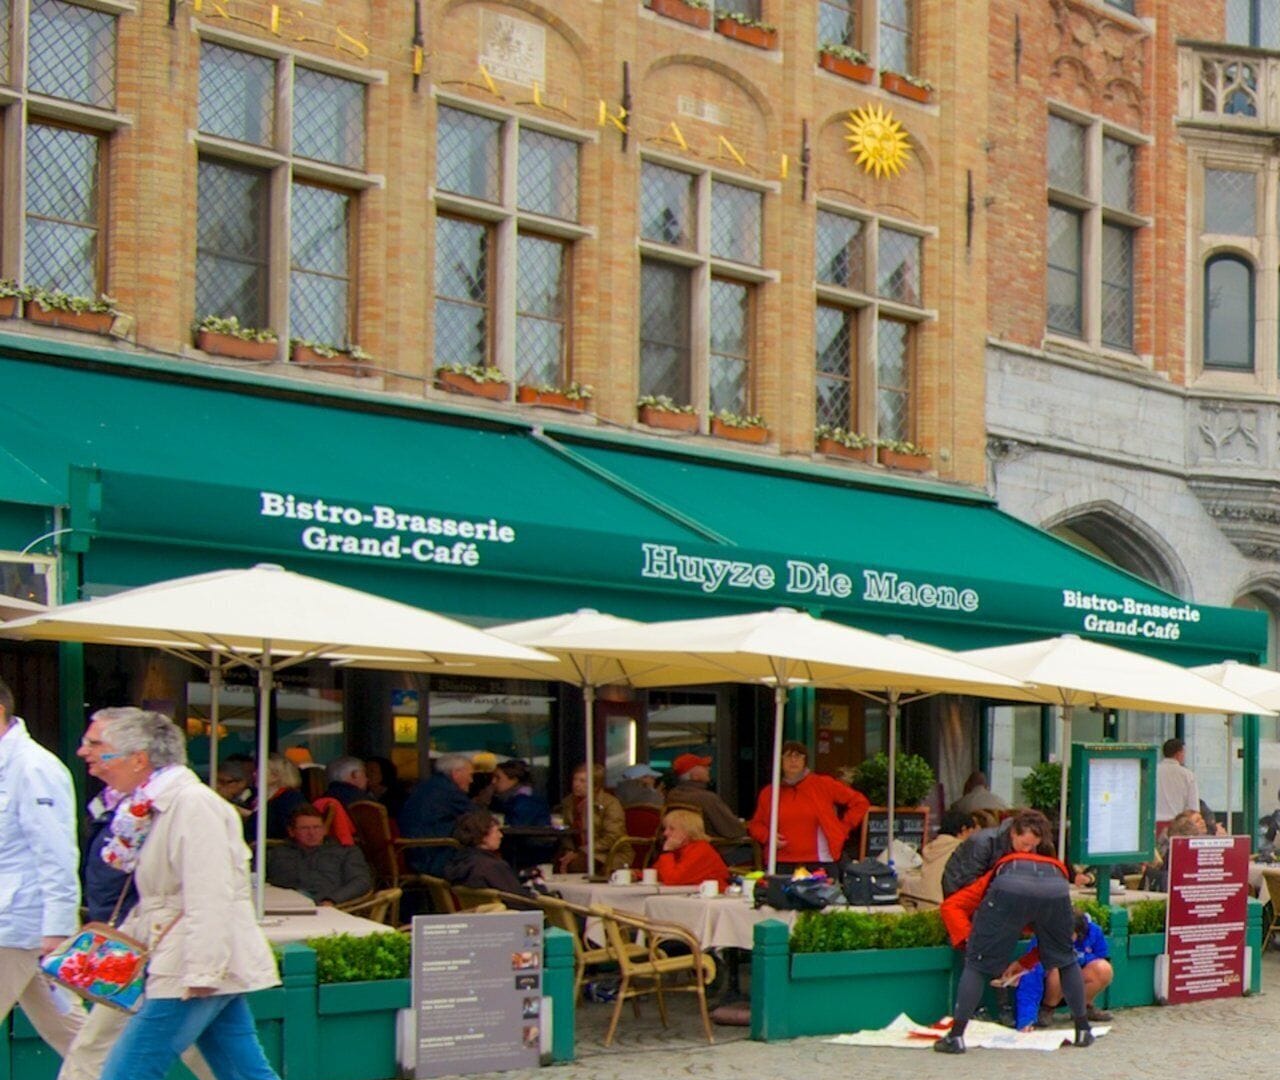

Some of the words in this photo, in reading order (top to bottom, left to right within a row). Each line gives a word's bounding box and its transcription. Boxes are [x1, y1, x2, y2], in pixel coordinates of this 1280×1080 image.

[260, 491, 516, 543] Bistro-Brasserie
[302, 526, 480, 567] Grand-Café
[642, 543, 775, 592] Huyze
[786, 560, 851, 597] Die
[863, 570, 979, 611] Maene
[1062, 589, 1201, 622] Bistro-Brasserie
[1084, 613, 1180, 640] Grand-Café
